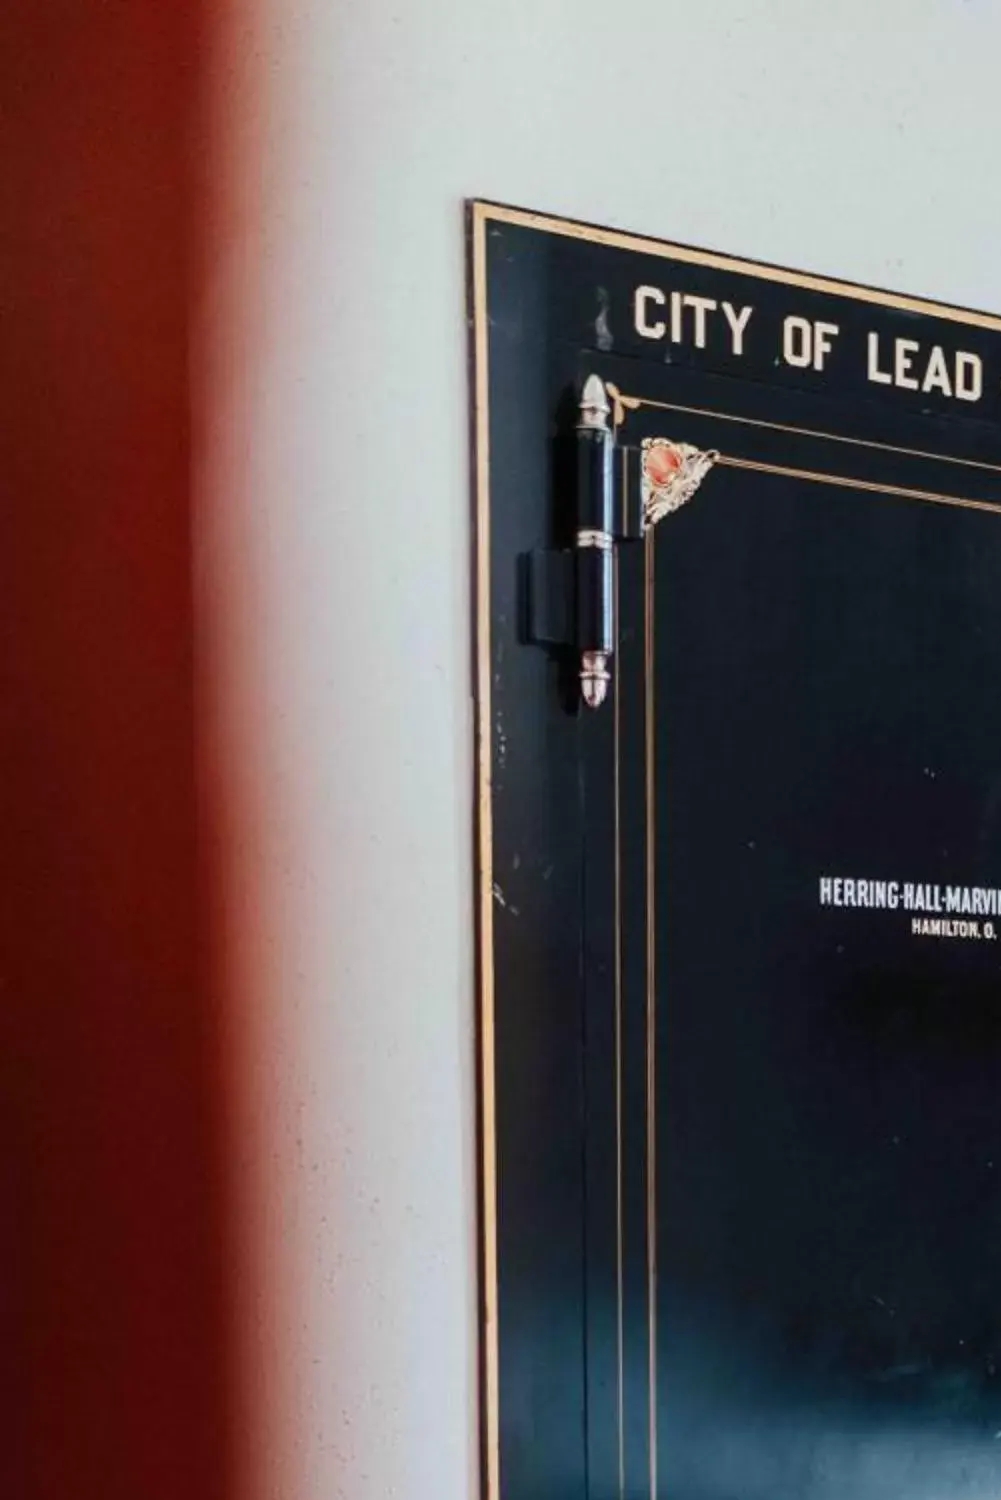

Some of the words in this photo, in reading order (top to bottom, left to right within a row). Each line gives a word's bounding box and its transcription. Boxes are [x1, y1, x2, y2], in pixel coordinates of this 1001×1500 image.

[633, 286, 753, 355] CITY
[782, 316, 839, 371] OF
[867, 332, 983, 401] LEAD
